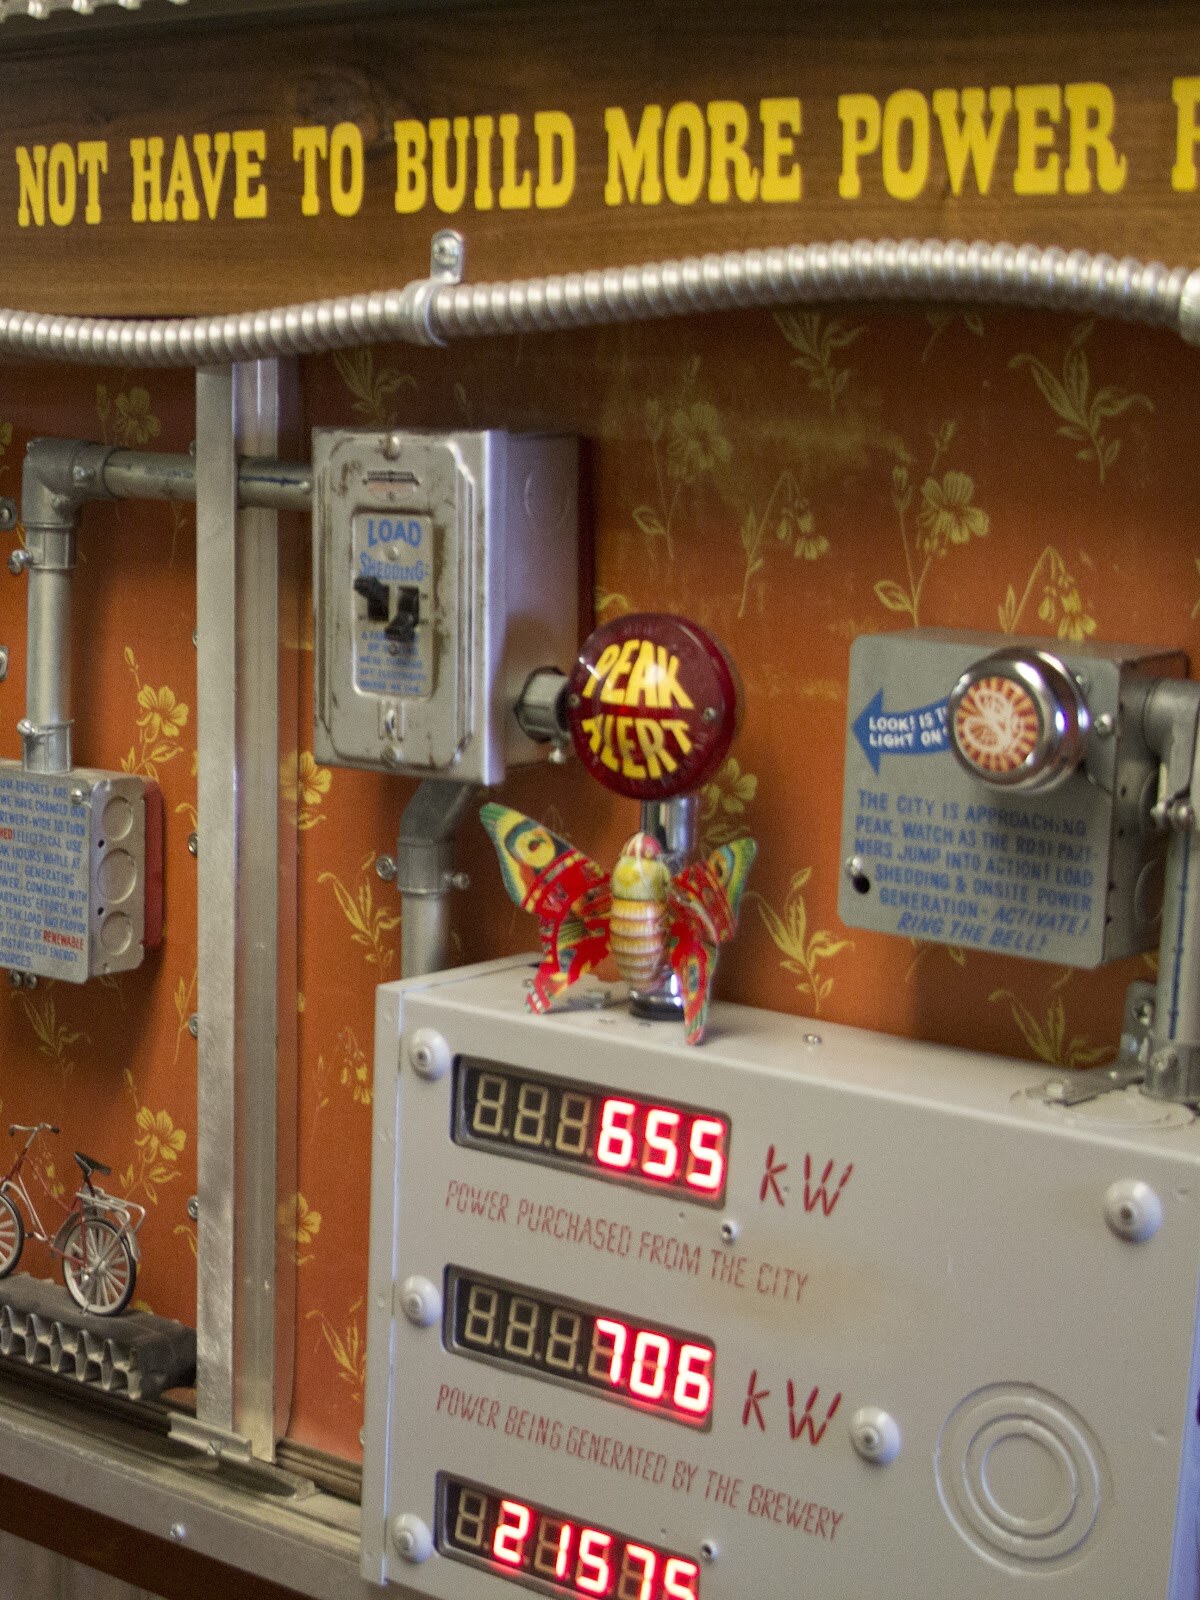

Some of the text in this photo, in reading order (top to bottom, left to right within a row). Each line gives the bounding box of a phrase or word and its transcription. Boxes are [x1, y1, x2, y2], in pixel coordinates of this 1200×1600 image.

[16, 141, 107, 227] NOT
[130, 129, 267, 222] HAVE
[293, 121, 363, 217] TO
[394, 110, 575, 213] BUILD
[604, 97, 800, 205] MORE
[838, 81, 1126, 200] POWER
[368, 519, 422, 548] LOAD
[582, 639, 694, 709] PEAK
[869, 715, 914, 732] LOOK!
[919, 712, 934, 728] IS
[869, 732, 914, 749] LIGHT
[582, 714, 692, 779] ALERT
[16, 780, 49, 796] EFFORTS
[52, 787, 67, 798] ARE
[36, 800, 68, 815] CHANGED
[858, 788, 1087, 838] THE CITY IS APPROACHING
[13, 846, 40, 860] HOURS
[43, 852, 67, 867] WHILE
[903, 822, 954, 844] WATCH
[959, 828, 976, 848] AS
[982, 831, 1009, 850] THE
[855, 837, 1094, 888] NERS JUMP INTO ACTION! LOAD
[875, 863, 1092, 912] SHEDDING & ONSITE POWER
[880, 887, 978, 918] GENERATION
[43, 930, 84, 951] RENEWABLE
[897, 912, 1048, 952] RING THE BELL!
[597, 1099, 726, 1189] 655
[446, 1179, 810, 1302] POWER PURCHASED FROM THE CITY
[596, 1318, 712, 1412] 706
[436, 1384, 847, 1541] POWER BEING GENERATED BY THE BREWERY
